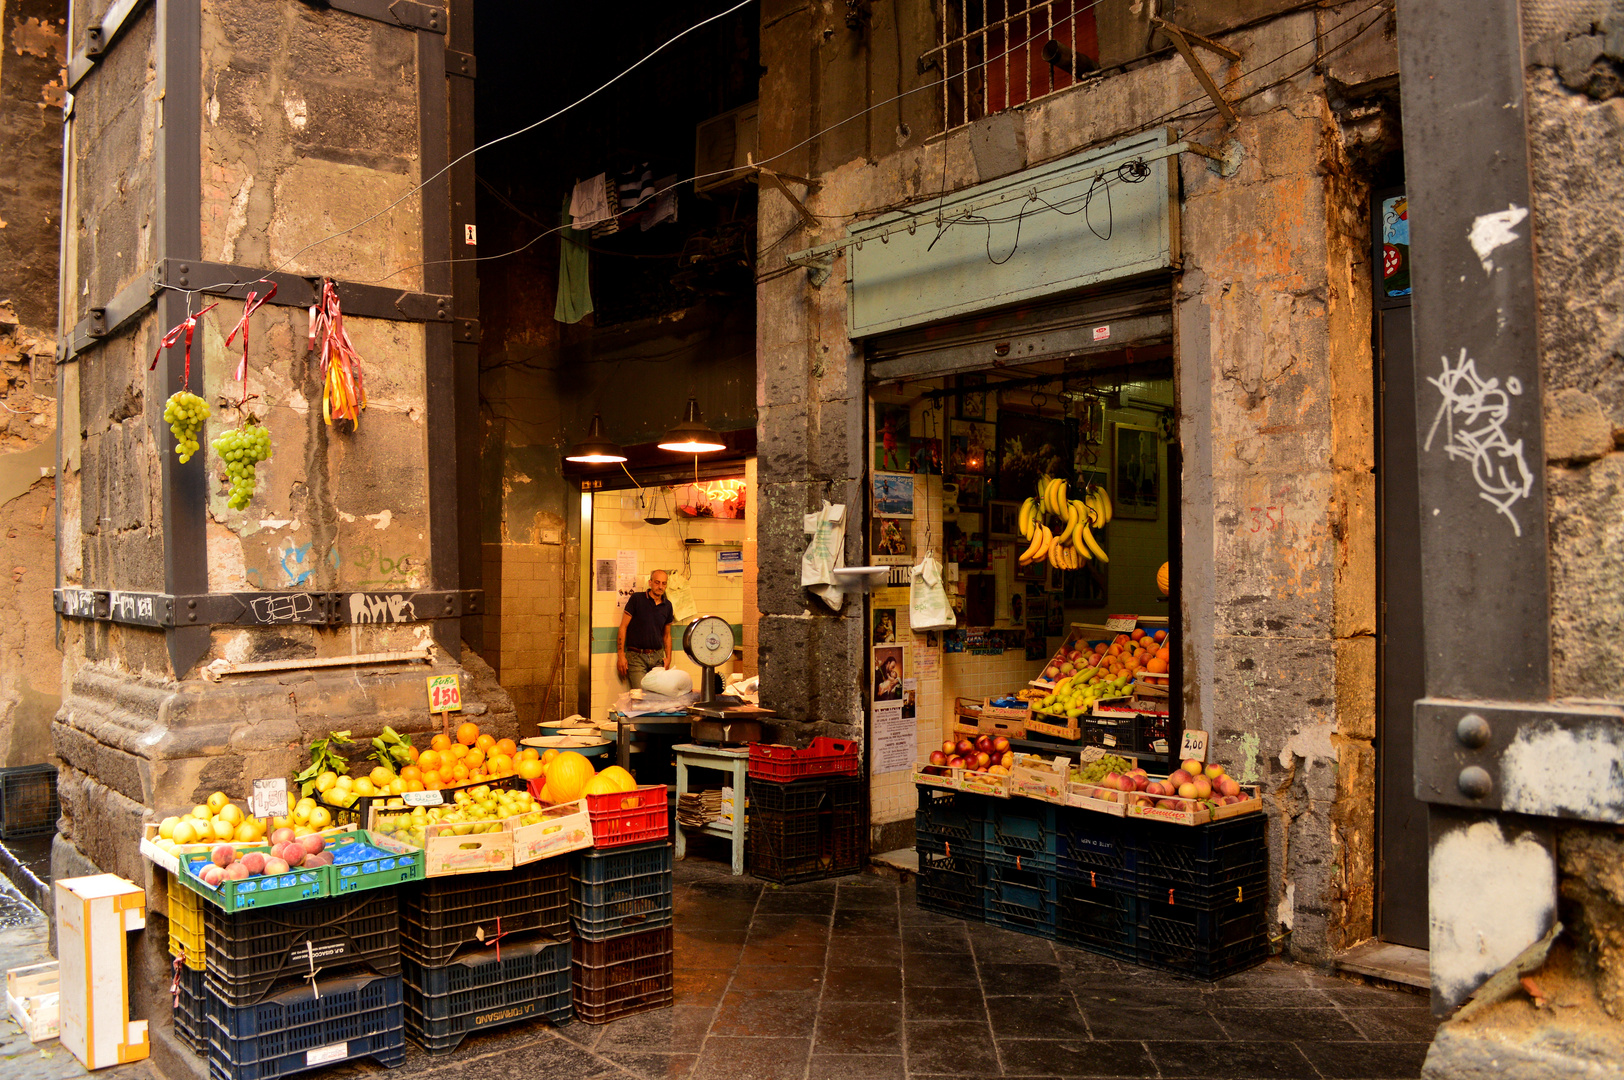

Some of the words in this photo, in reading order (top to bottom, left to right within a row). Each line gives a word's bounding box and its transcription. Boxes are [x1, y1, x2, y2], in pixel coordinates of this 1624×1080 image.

[1250, 506, 1284, 533] 351
[1184, 739, 1203, 752] 2,00
[255, 789, 286, 812] 1,50
[1142, 807, 1186, 820] Genuino
[475, 1006, 523, 1025] FORMISANO
[523, 1003, 535, 1014] LA
